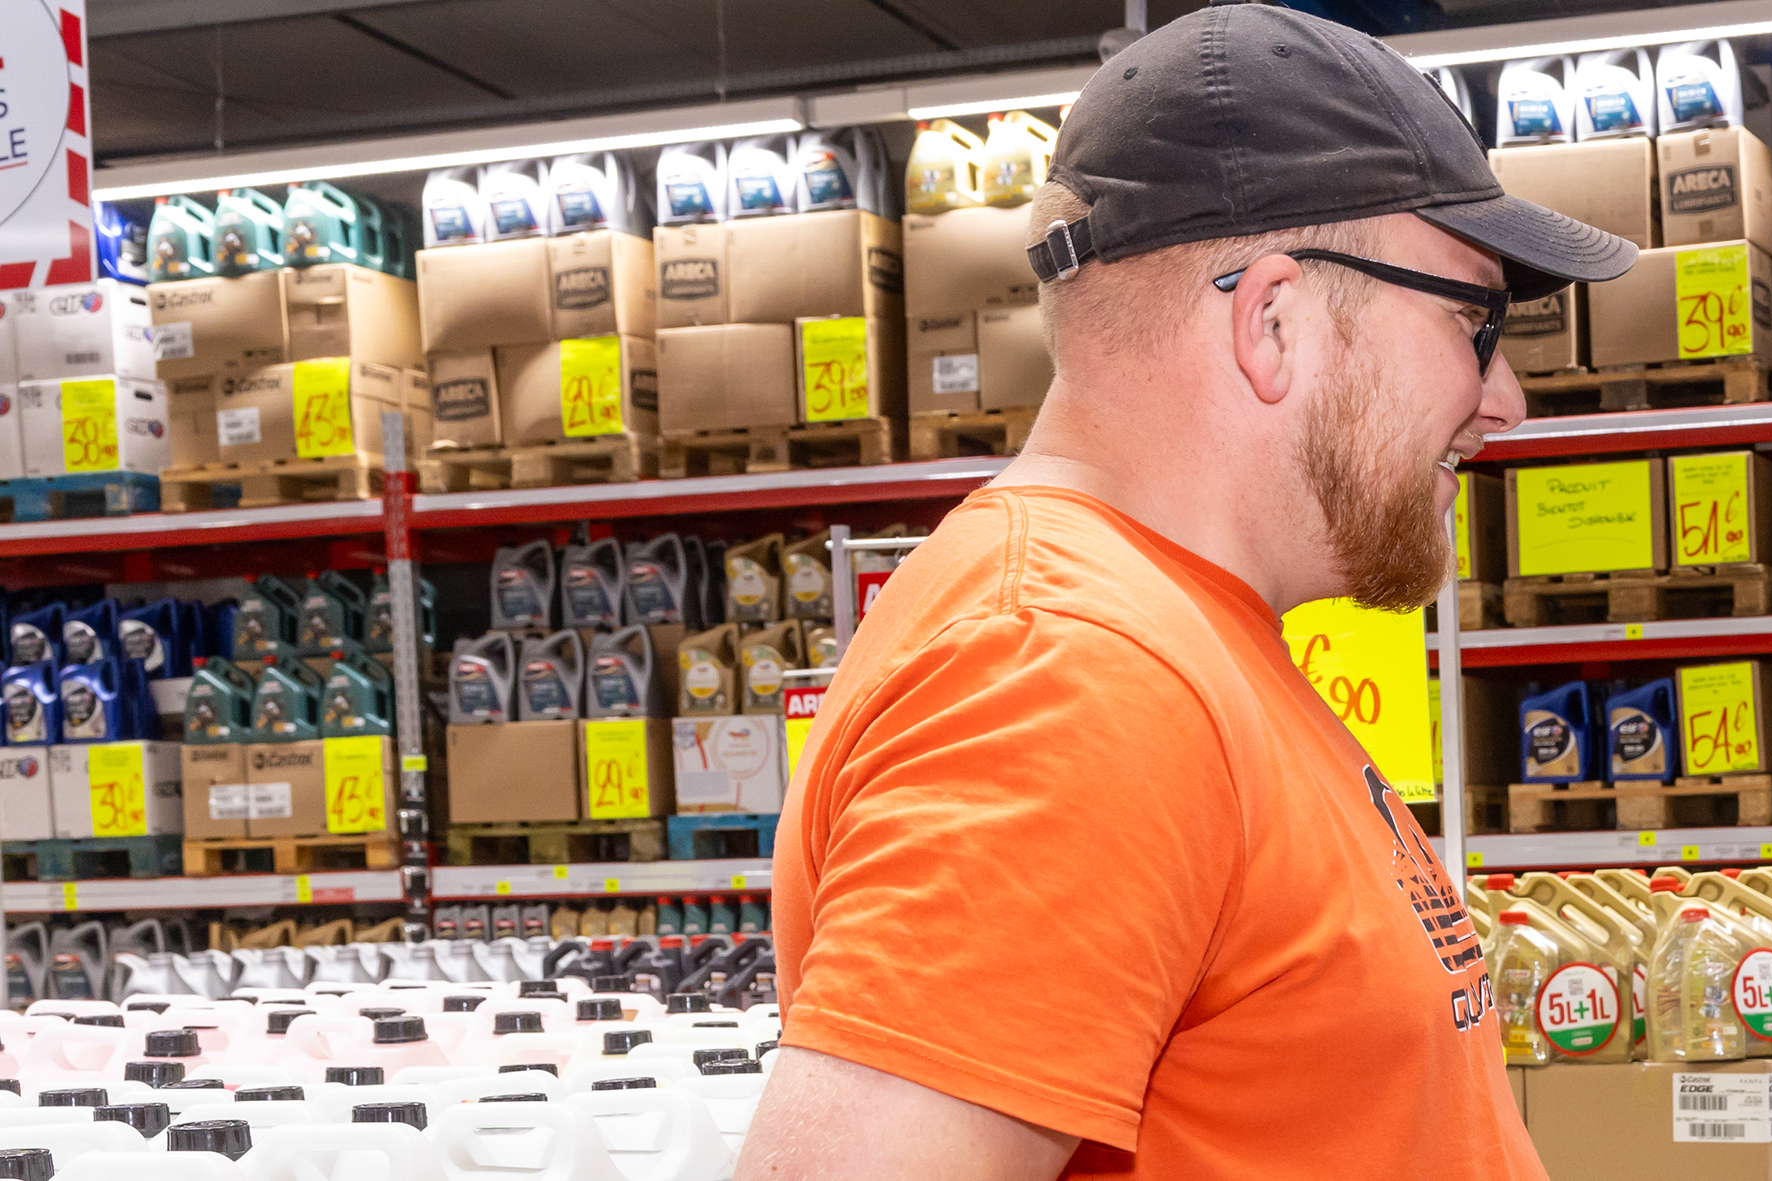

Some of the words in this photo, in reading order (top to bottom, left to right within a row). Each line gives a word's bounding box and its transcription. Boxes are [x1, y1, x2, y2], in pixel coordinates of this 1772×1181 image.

[1673, 168, 1731, 195] ARECA
[1687, 1075, 1711, 1083] Castrol
[1680, 1085, 1714, 1093] EDGE
